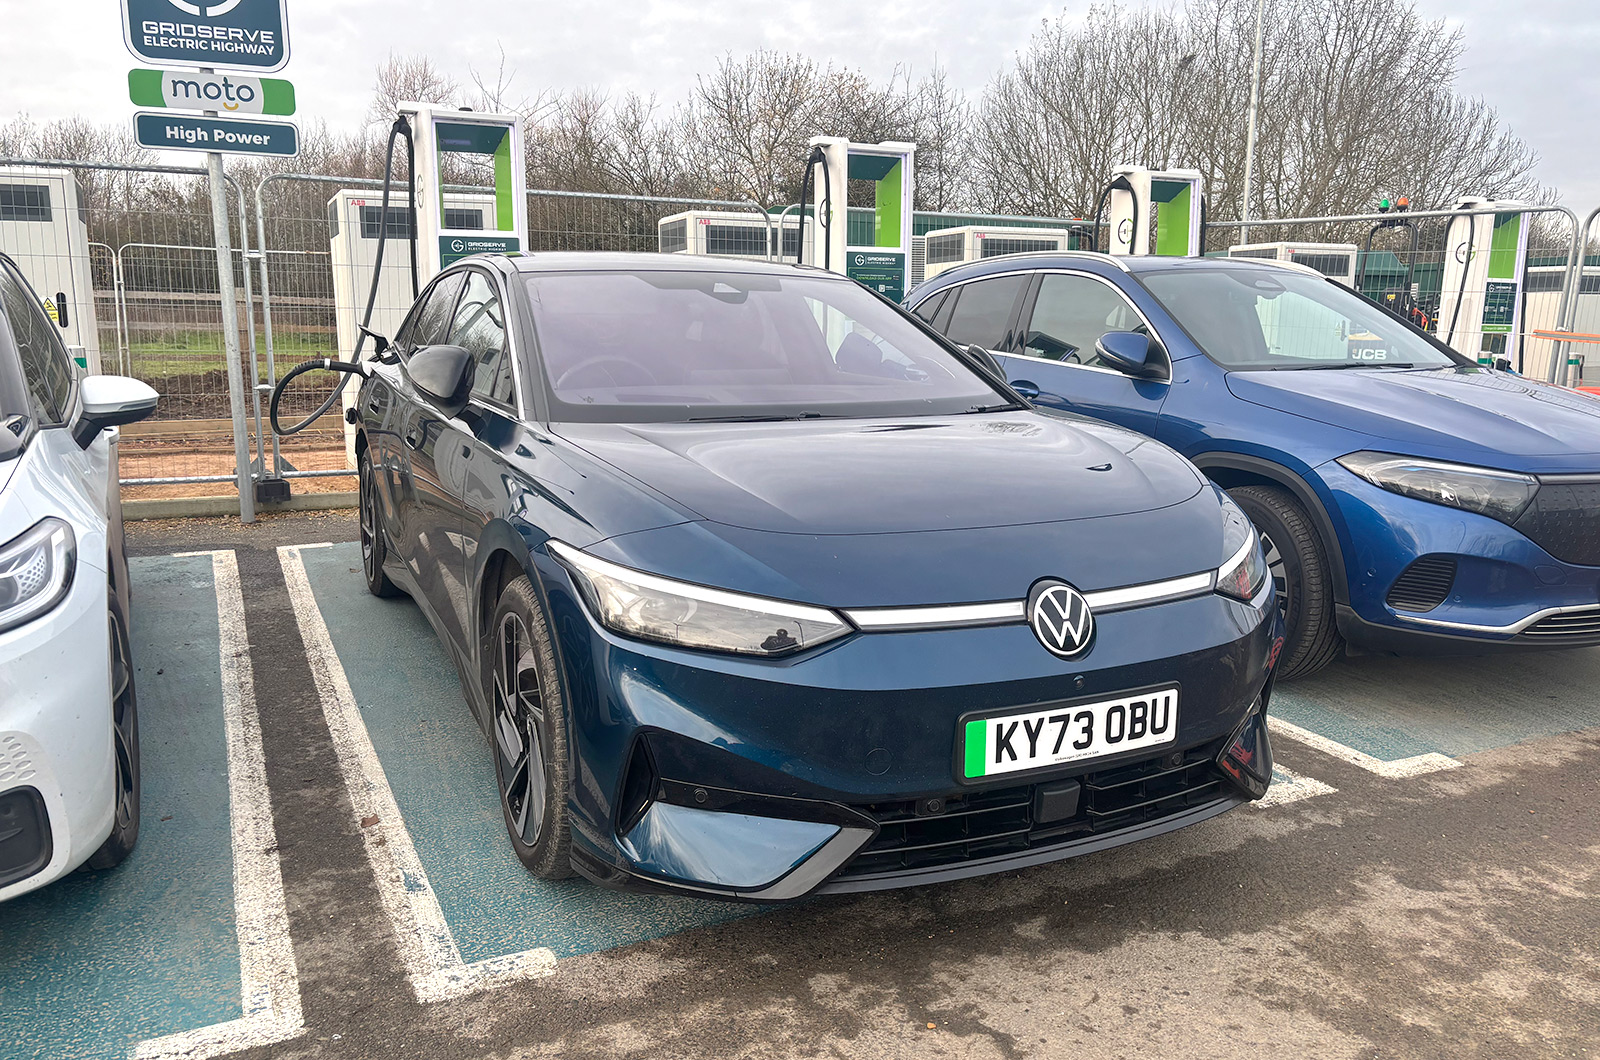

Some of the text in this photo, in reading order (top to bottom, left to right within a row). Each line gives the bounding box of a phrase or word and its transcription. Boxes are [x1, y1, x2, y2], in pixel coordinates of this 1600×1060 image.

[142, 20, 275, 44] GRIDSERVE
[143, 35, 275, 56] ELECTRIC HIGHWAY
[171, 76, 255, 102] moto
[165, 125, 271, 145] High Power
[1352, 348, 1387, 360] JCB
[995, 696, 1170, 764] KY73 OBU
